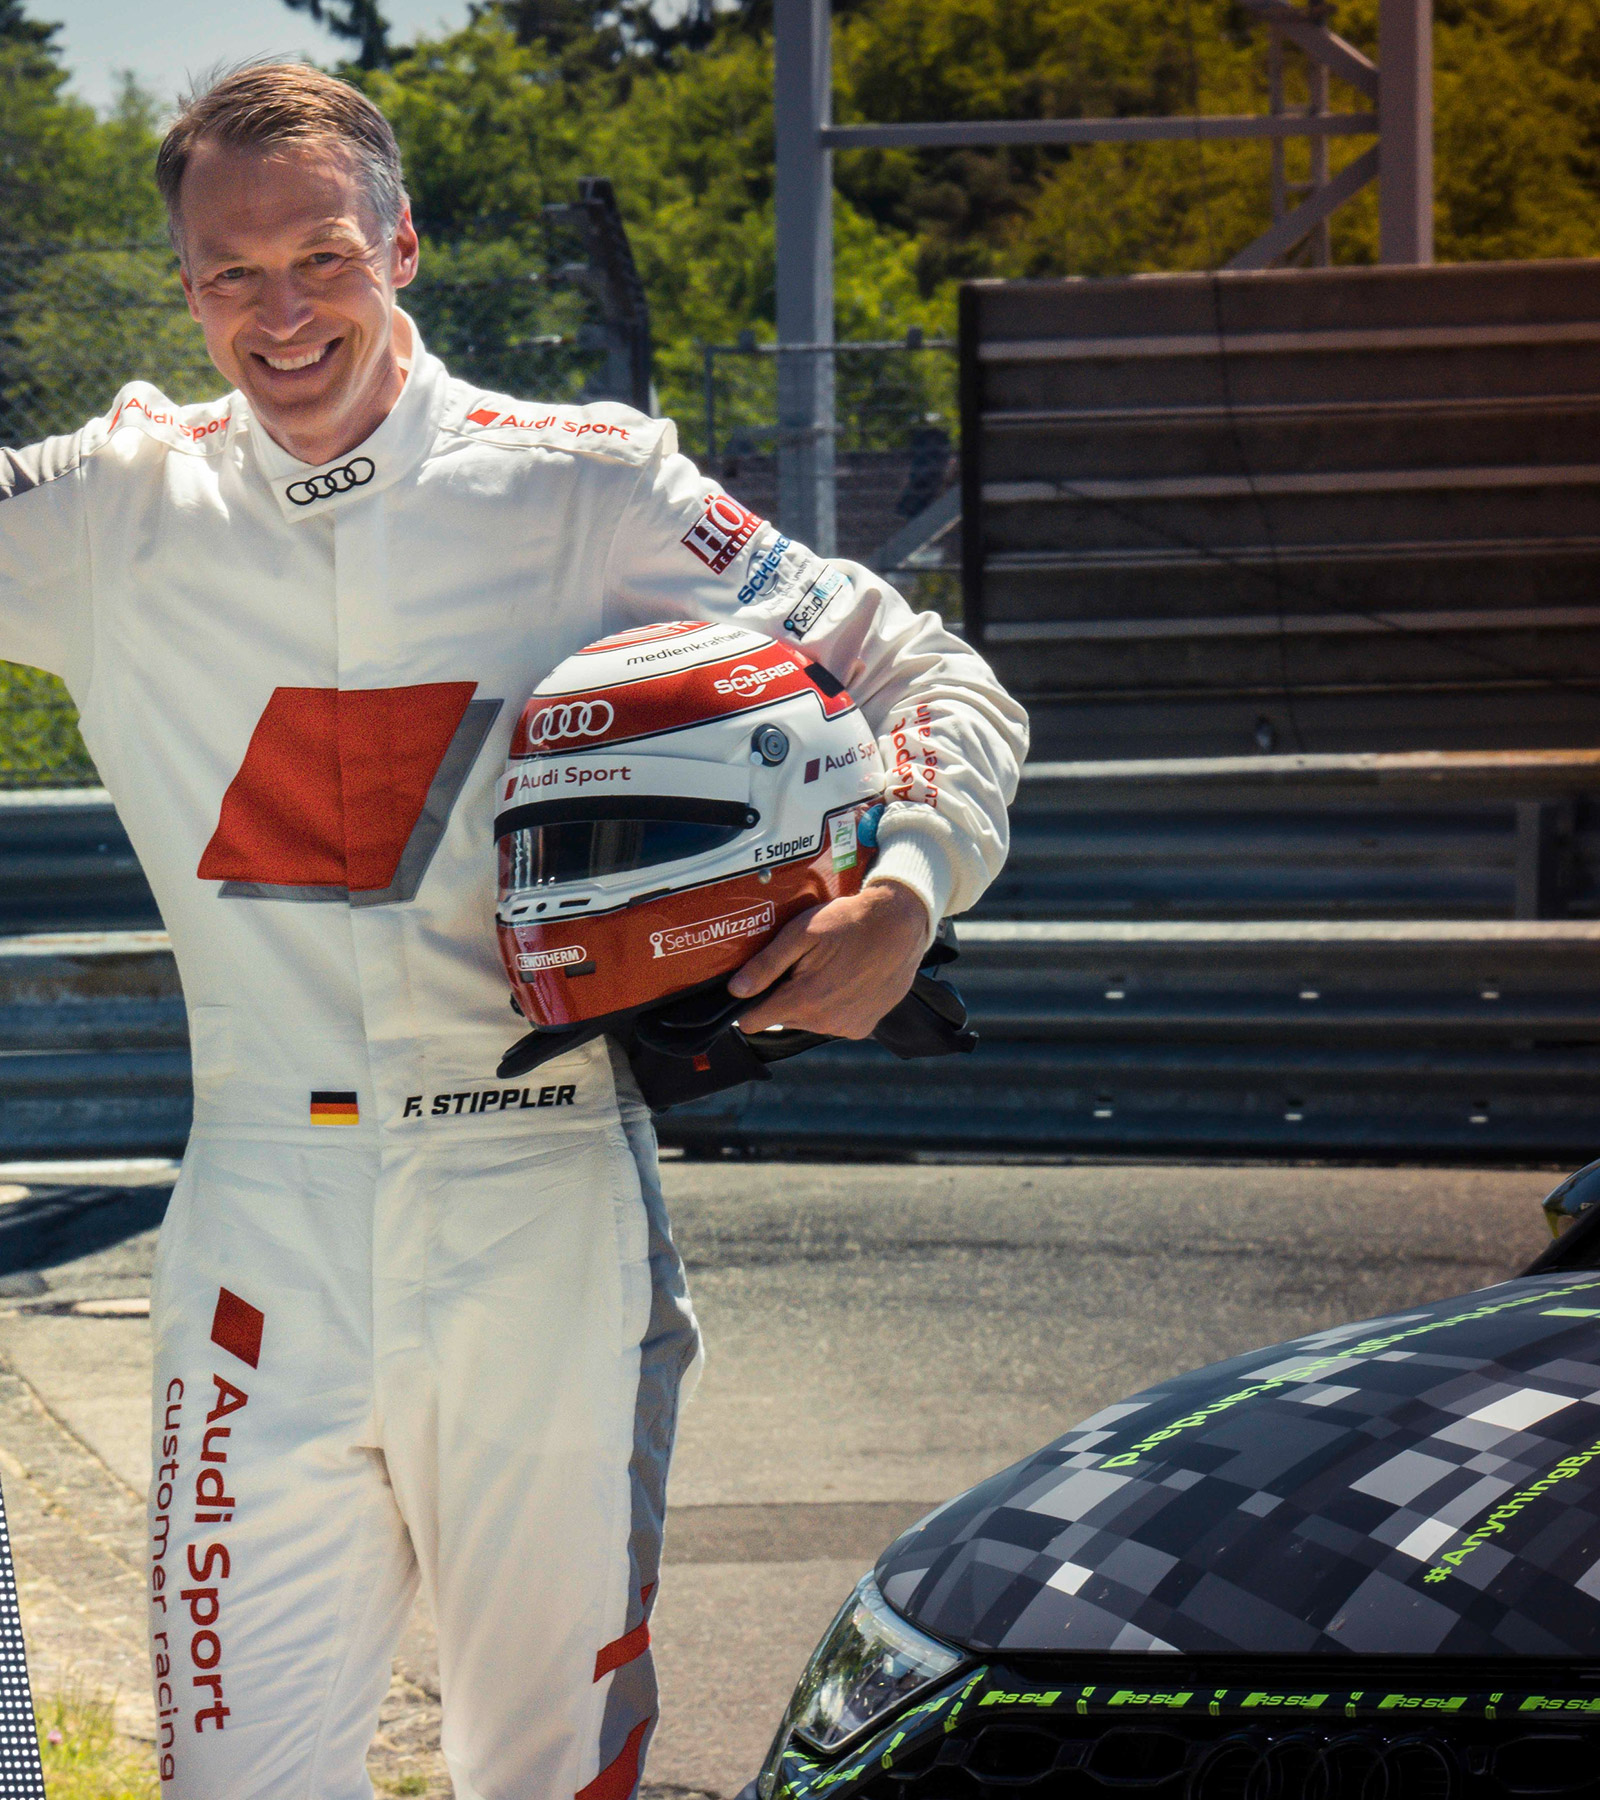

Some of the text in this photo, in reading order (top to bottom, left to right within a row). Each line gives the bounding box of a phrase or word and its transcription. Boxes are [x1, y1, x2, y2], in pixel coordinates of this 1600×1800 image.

[124, 398, 232, 441] Audi Spor
[500, 414, 631, 441] Audi Sport
[683, 494, 749, 564] HÖ
[713, 660, 799, 695] SCHERER
[825, 746, 858, 772] Audi
[518, 765, 632, 790] Audi Sport
[754, 847, 763, 862] F.
[766, 834, 815, 859] Stippler
[665, 907, 772, 951] SetupWizzard
[402, 1084, 577, 1118] F. STIPPLER
[180, 1372, 249, 1734] Audi Sport
[150, 1377, 185, 1782] customer racing
